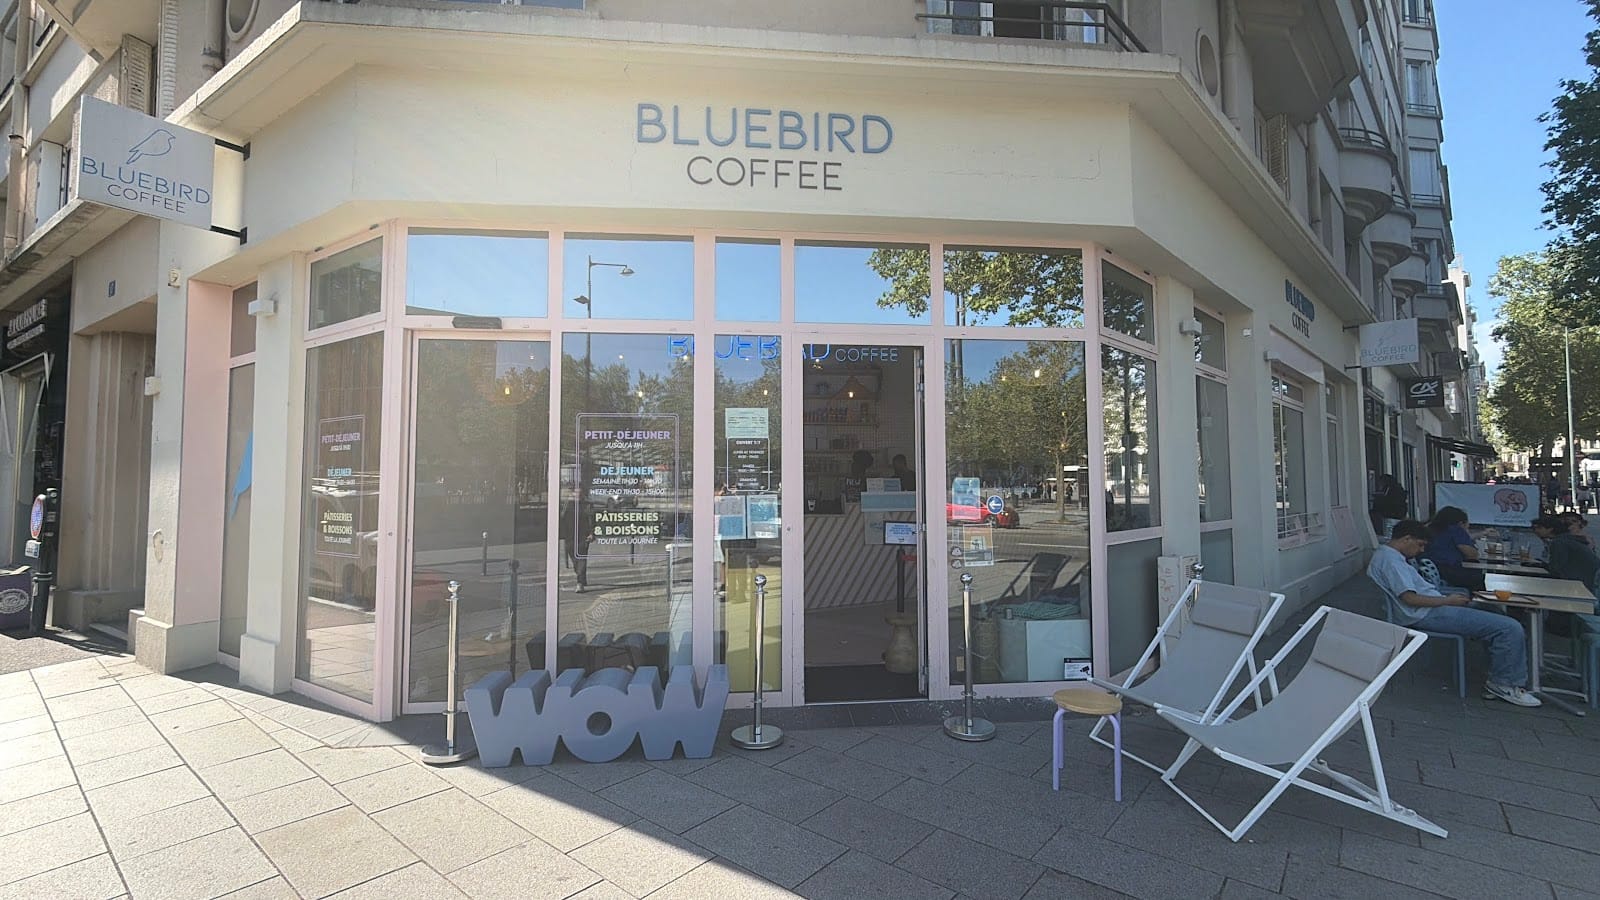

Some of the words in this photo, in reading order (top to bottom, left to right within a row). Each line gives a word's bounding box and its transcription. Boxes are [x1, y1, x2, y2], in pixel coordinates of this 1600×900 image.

[637, 103, 893, 154] BLUEBIRD
[687, 156, 843, 190] COFFEE
[82, 156, 210, 205] BLUEBIRD
[107, 184, 186, 213] COFFEE
[835, 348, 898, 362] COFFEE
[1361, 344, 1417, 357] BLUEBIRD
[1371, 353, 1406, 363] COFFEE
[585, 428, 671, 440] PETIT-DÉJEUNER
[595, 510, 659, 522] PÂTISSERIES
[594, 526, 602, 535] &
[605, 526, 659, 535] BOISSONS
[598, 537, 617, 545] TOUTE
[618, 537, 627, 545] LA
[464, 666, 730, 767] WOW
